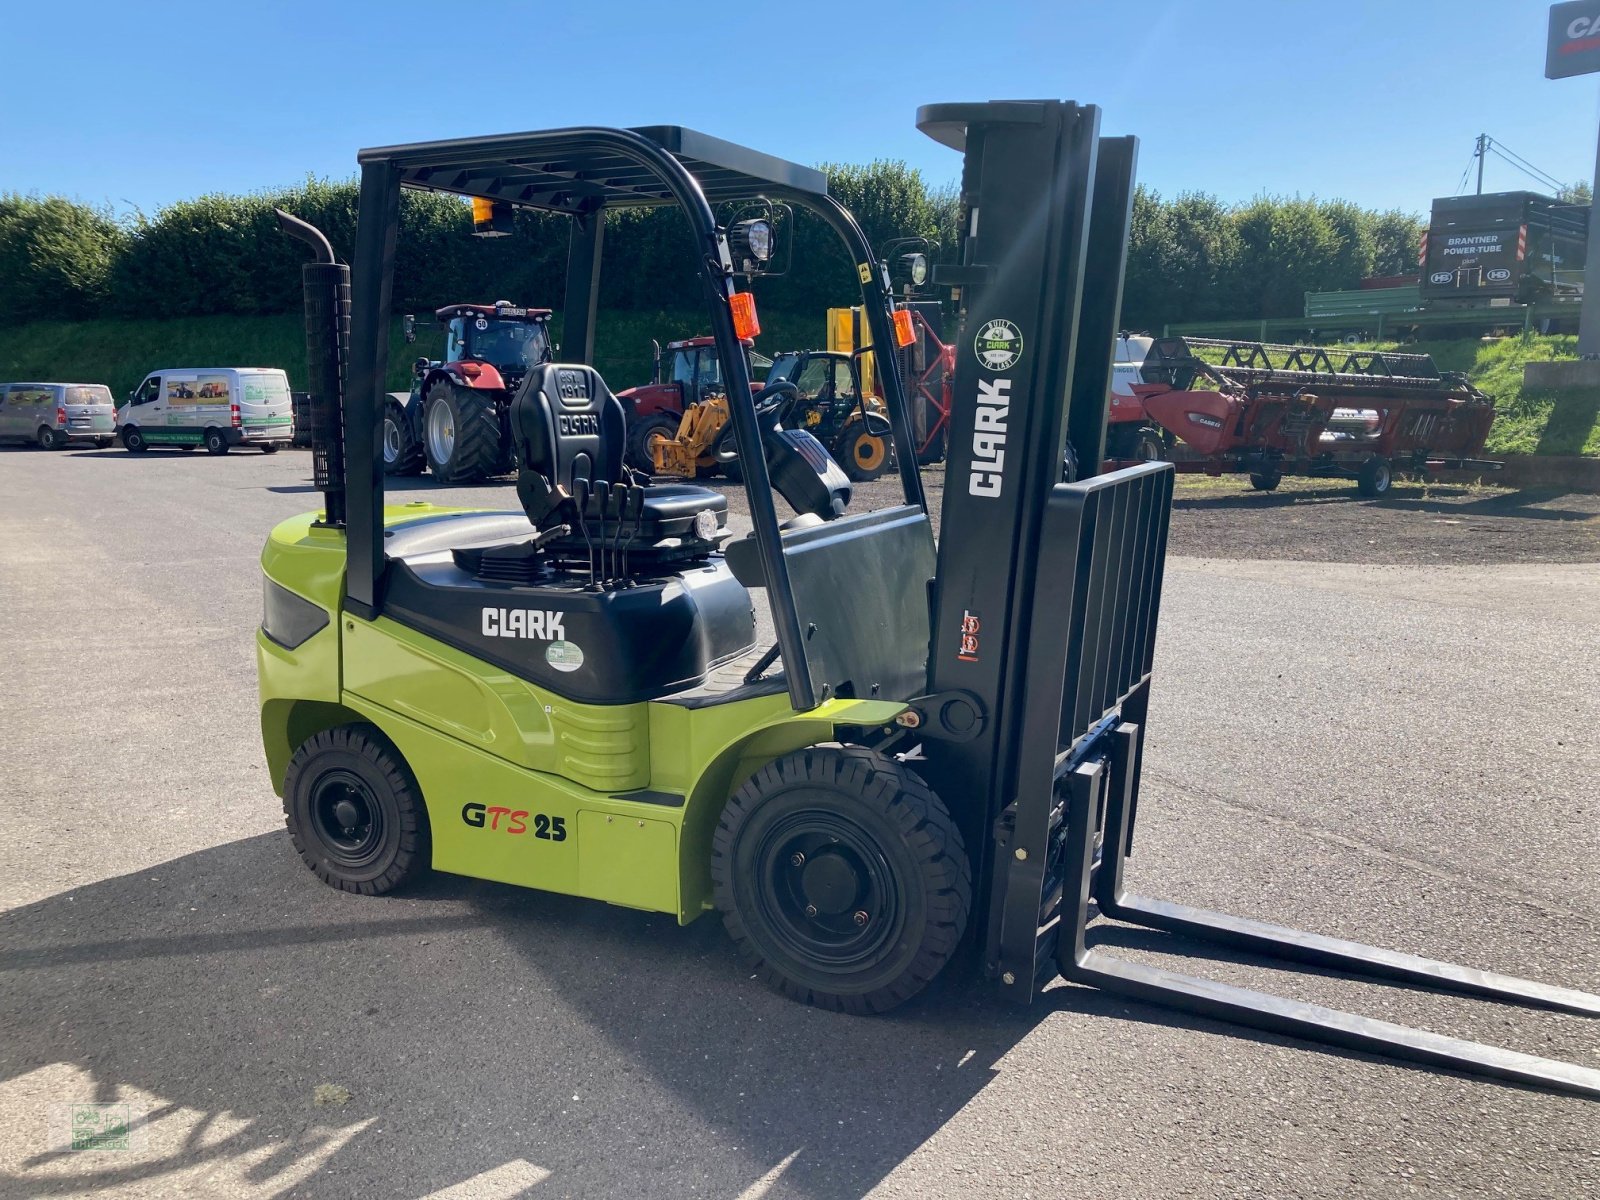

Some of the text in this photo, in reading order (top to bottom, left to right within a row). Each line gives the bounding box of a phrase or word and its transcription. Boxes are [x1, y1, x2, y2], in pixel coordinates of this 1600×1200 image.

[1448, 236, 1499, 245] BRANTNER
[477, 320, 486, 328] 50
[988, 320, 1010, 329] BUILT
[986, 340, 1010, 350] CLARK
[561, 384, 586, 398] 1917
[969, 378, 1012, 498] CLARK
[482, 607, 565, 641] CLARK
[461, 802, 567, 842] GTS 25
